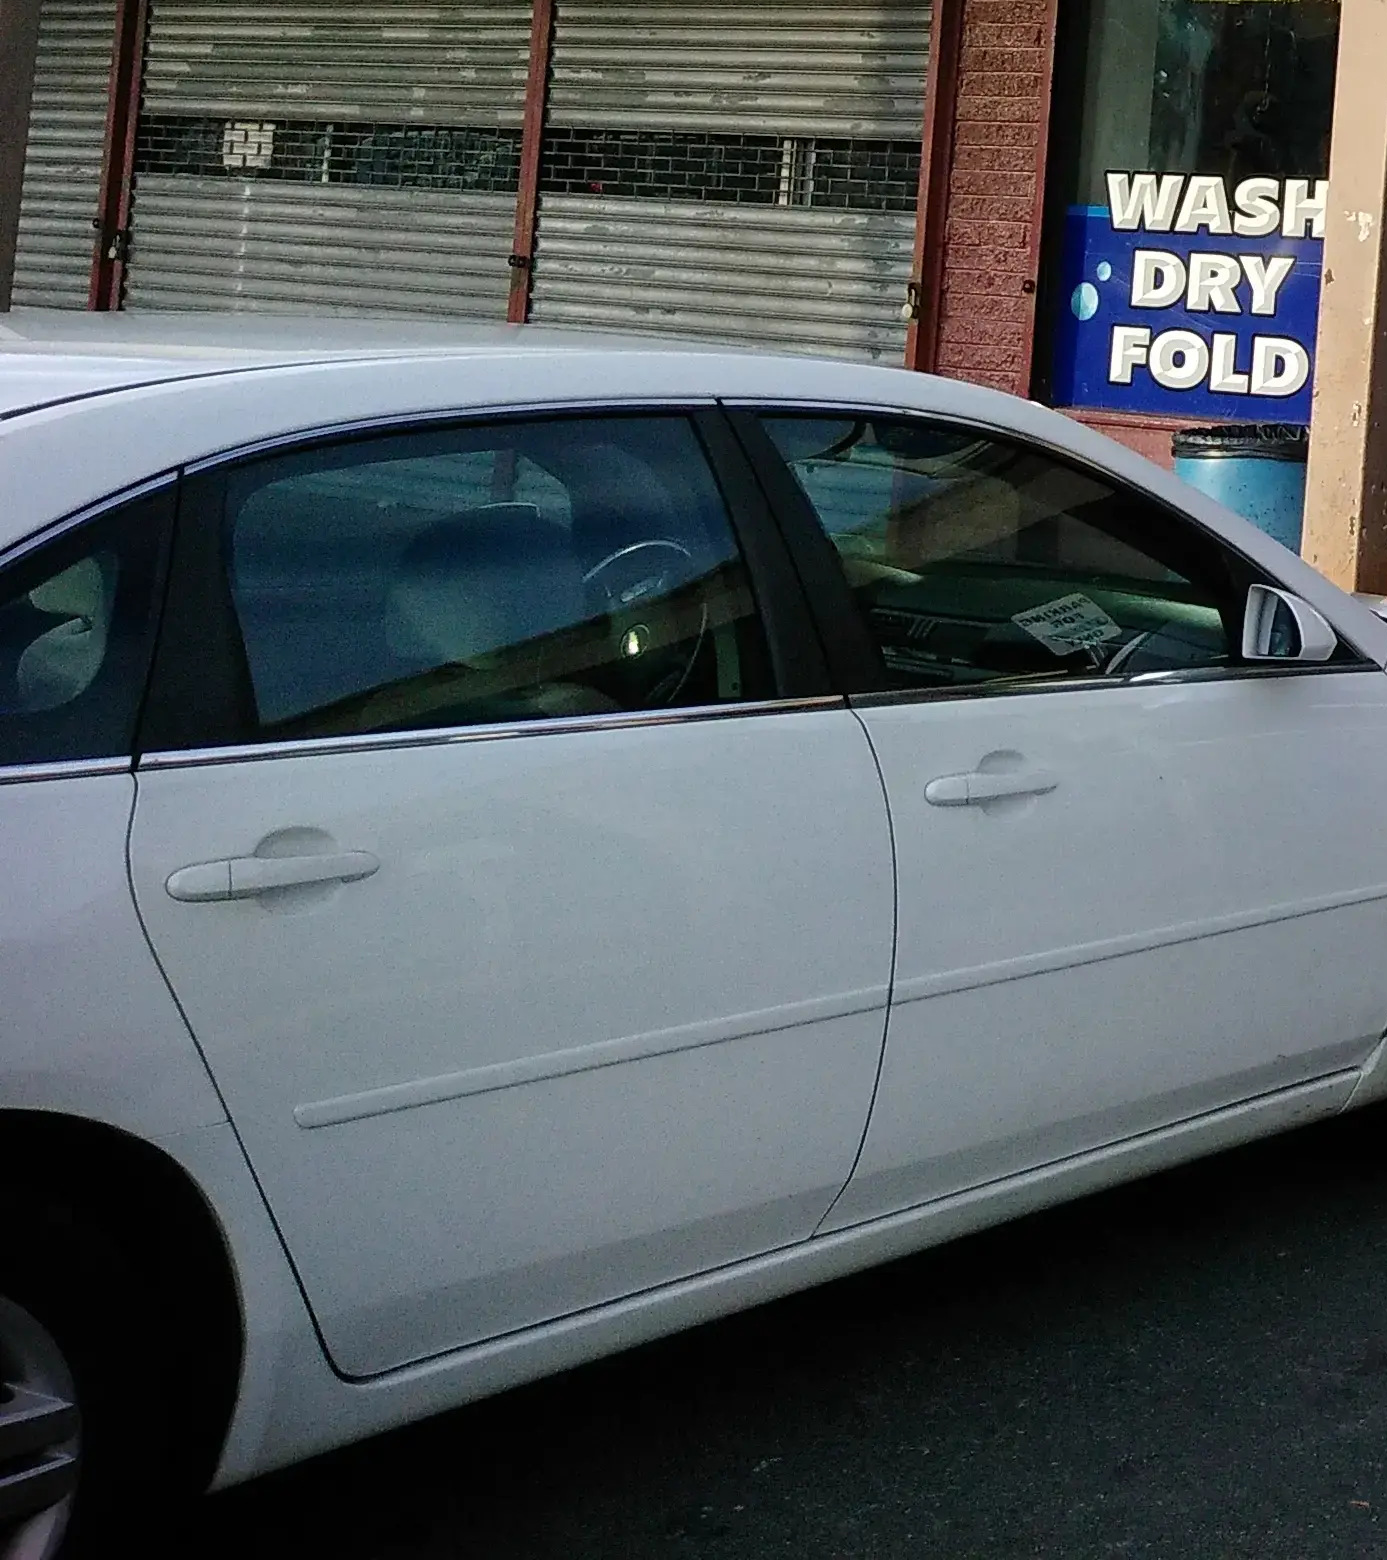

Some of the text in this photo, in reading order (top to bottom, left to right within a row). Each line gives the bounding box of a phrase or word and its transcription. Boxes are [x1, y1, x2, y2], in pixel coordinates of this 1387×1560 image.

[1106, 172, 1329, 237] WASH
[1131, 248, 1295, 316] DRY
[1108, 325, 1309, 397] FOLD
